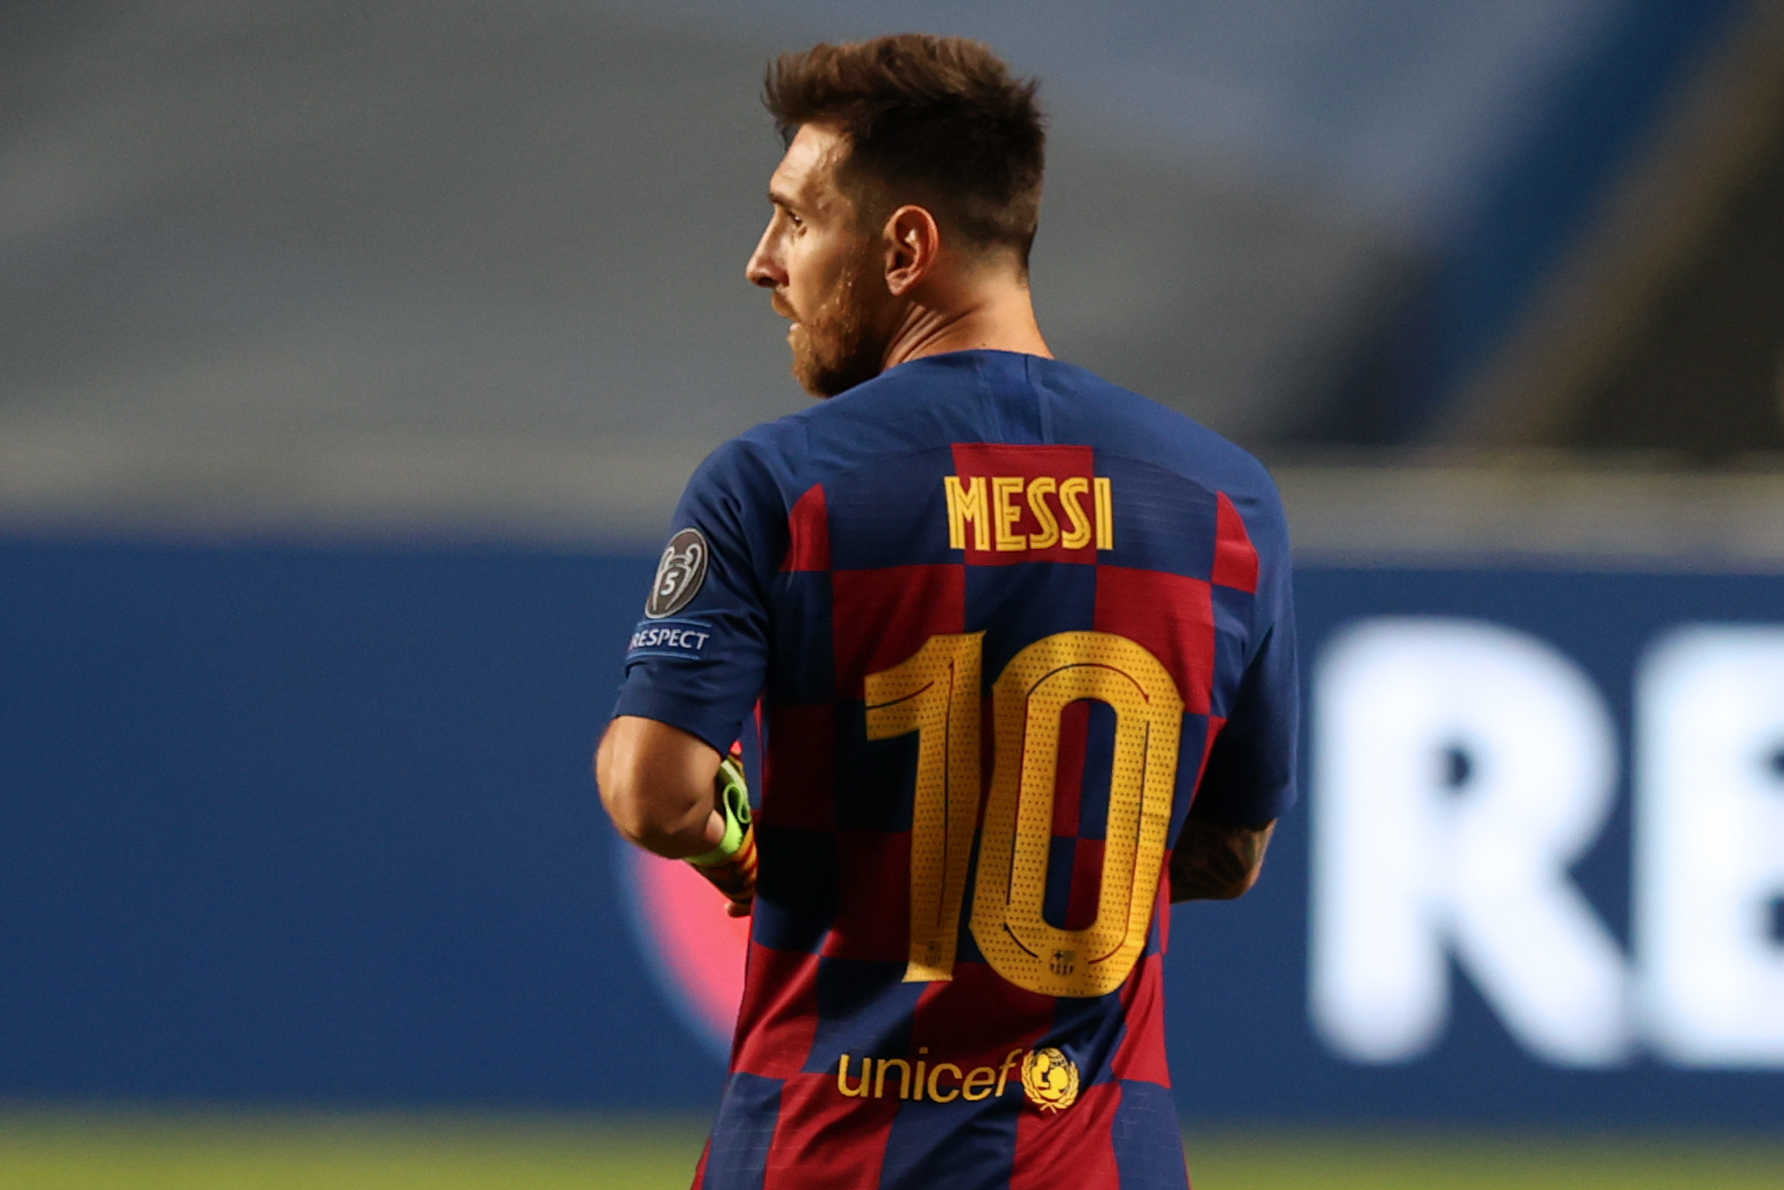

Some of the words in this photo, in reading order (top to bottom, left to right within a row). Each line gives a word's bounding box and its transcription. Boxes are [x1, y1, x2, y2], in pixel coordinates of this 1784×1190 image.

[944, 476, 1113, 551] MESSI
[660, 572, 679, 595] 5
[864, 630, 1185, 998] 10
[837, 1047, 1023, 1103] unicef
